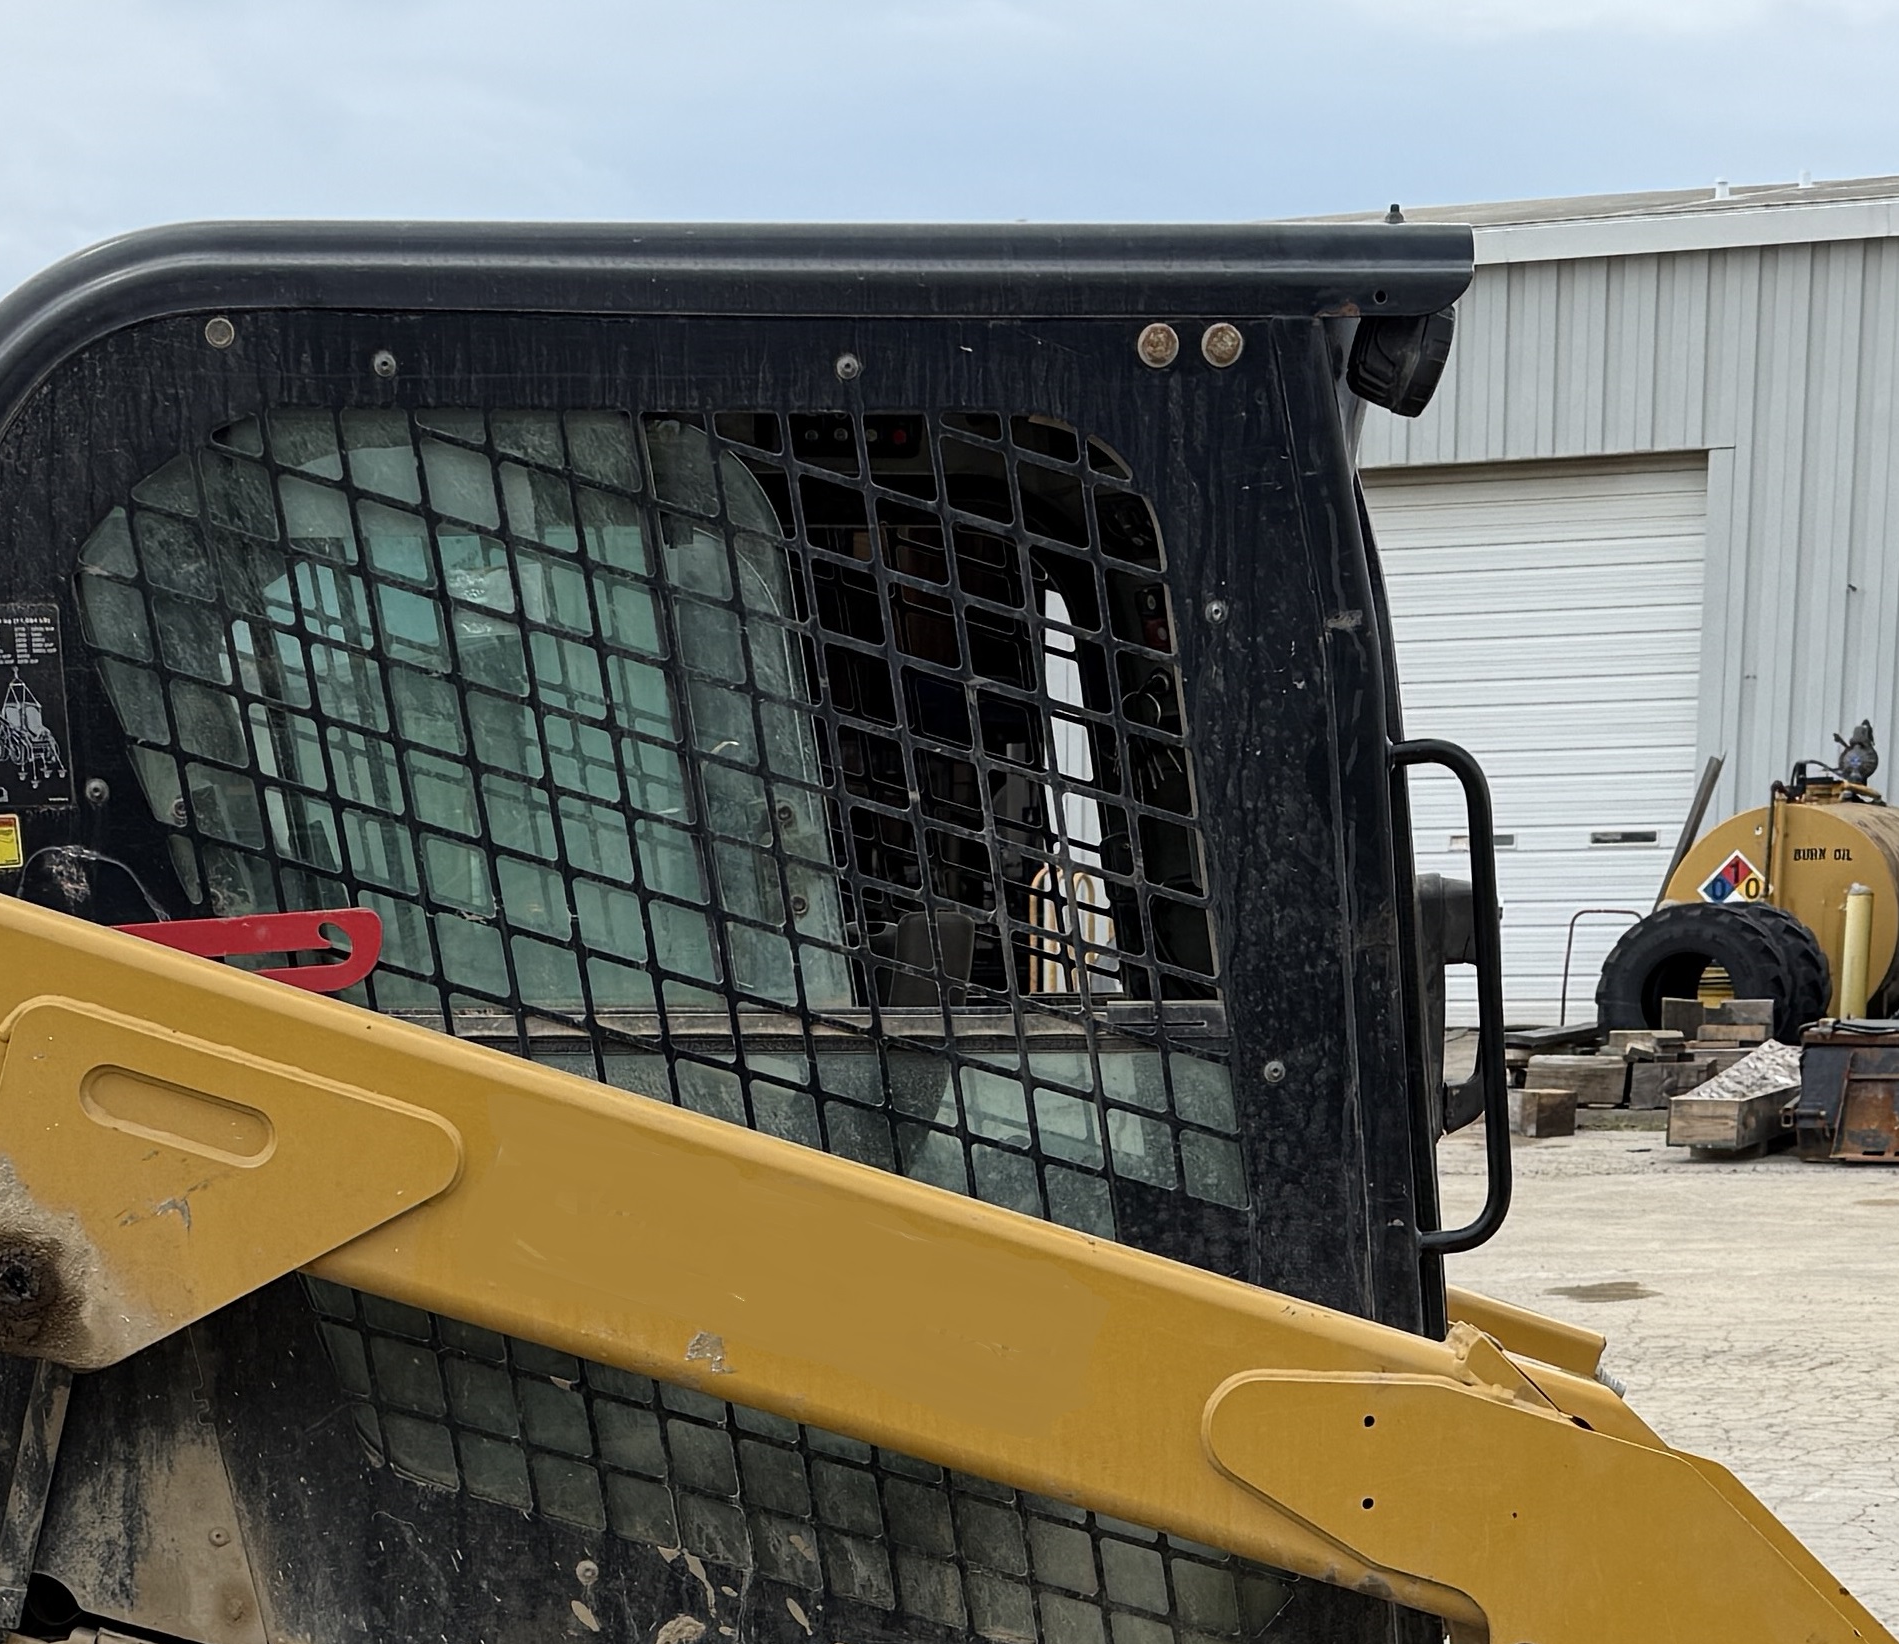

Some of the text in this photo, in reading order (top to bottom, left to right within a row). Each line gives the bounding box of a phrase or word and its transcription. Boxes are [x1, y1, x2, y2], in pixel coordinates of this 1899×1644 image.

[1834, 848, 1853, 861] OIL
[1729, 861, 1740, 885] 1
[1710, 876, 1761, 900] 0 0
